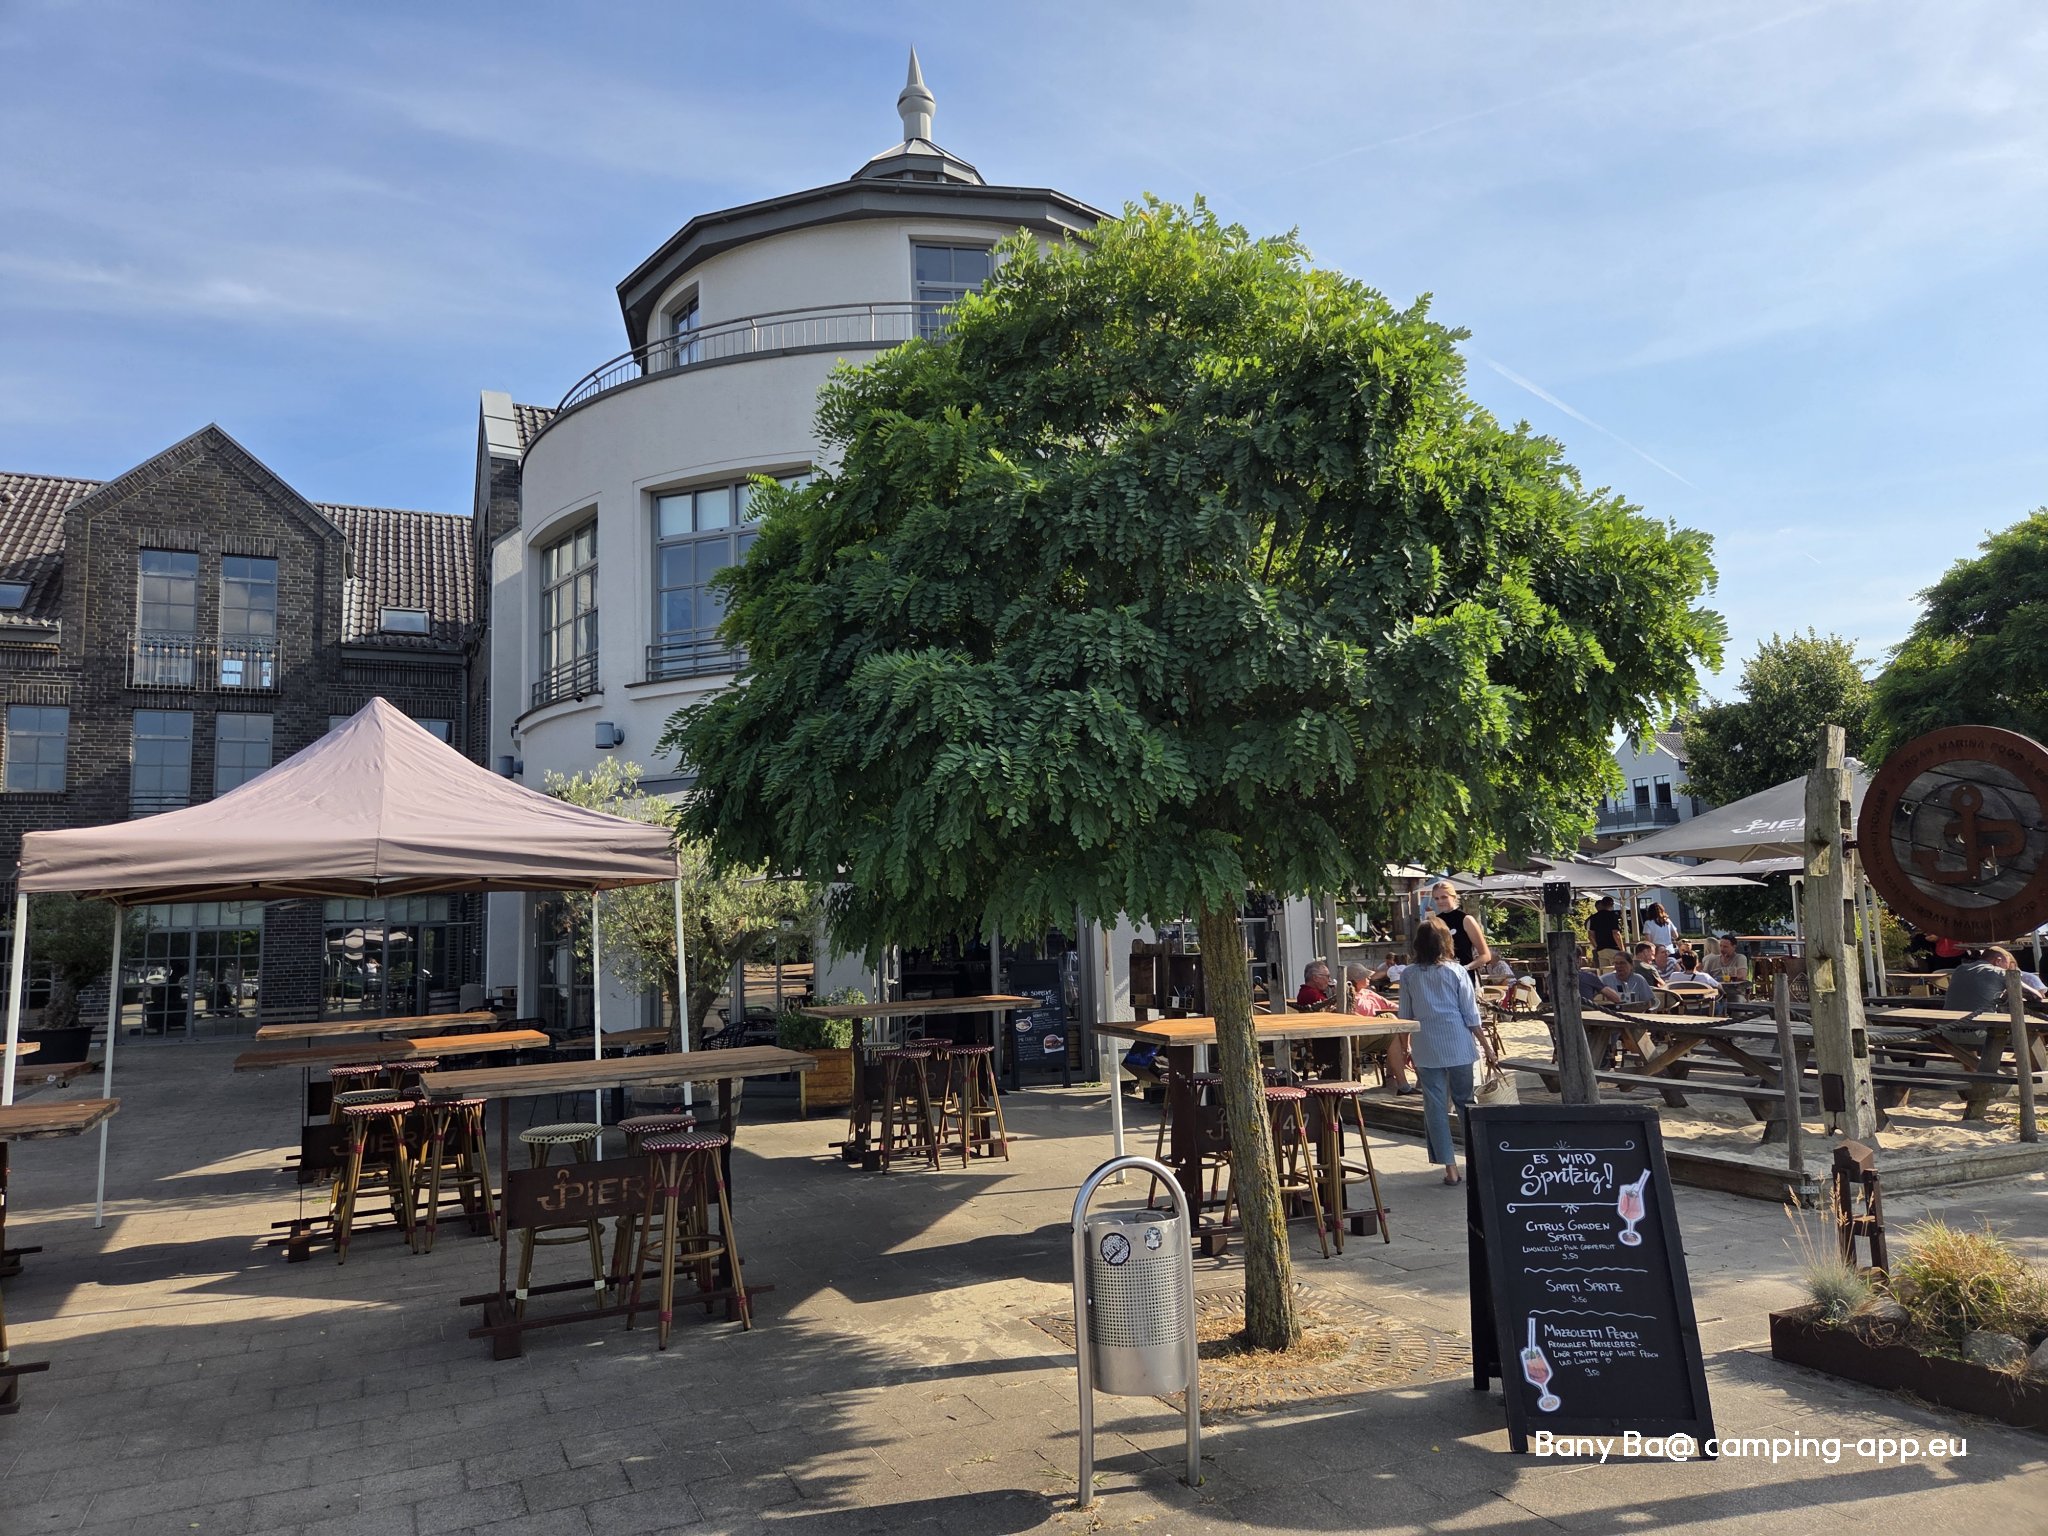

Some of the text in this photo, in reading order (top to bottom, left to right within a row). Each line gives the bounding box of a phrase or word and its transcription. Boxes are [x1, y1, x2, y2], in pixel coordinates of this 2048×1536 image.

[1532, 1152, 1597, 1165] ES WIRD
[1520, 1162, 1614, 1197] Spritzig!
[541, 1172, 646, 1210] PIER
[1525, 1219, 1611, 1232] CITRUS GARDEN
[1547, 1231, 1586, 1243] SPRITZ
[1545, 1278, 1624, 1292] SARTI SPRITZ
[1544, 1324, 1639, 1340] MAZZOLETTI PEACH
